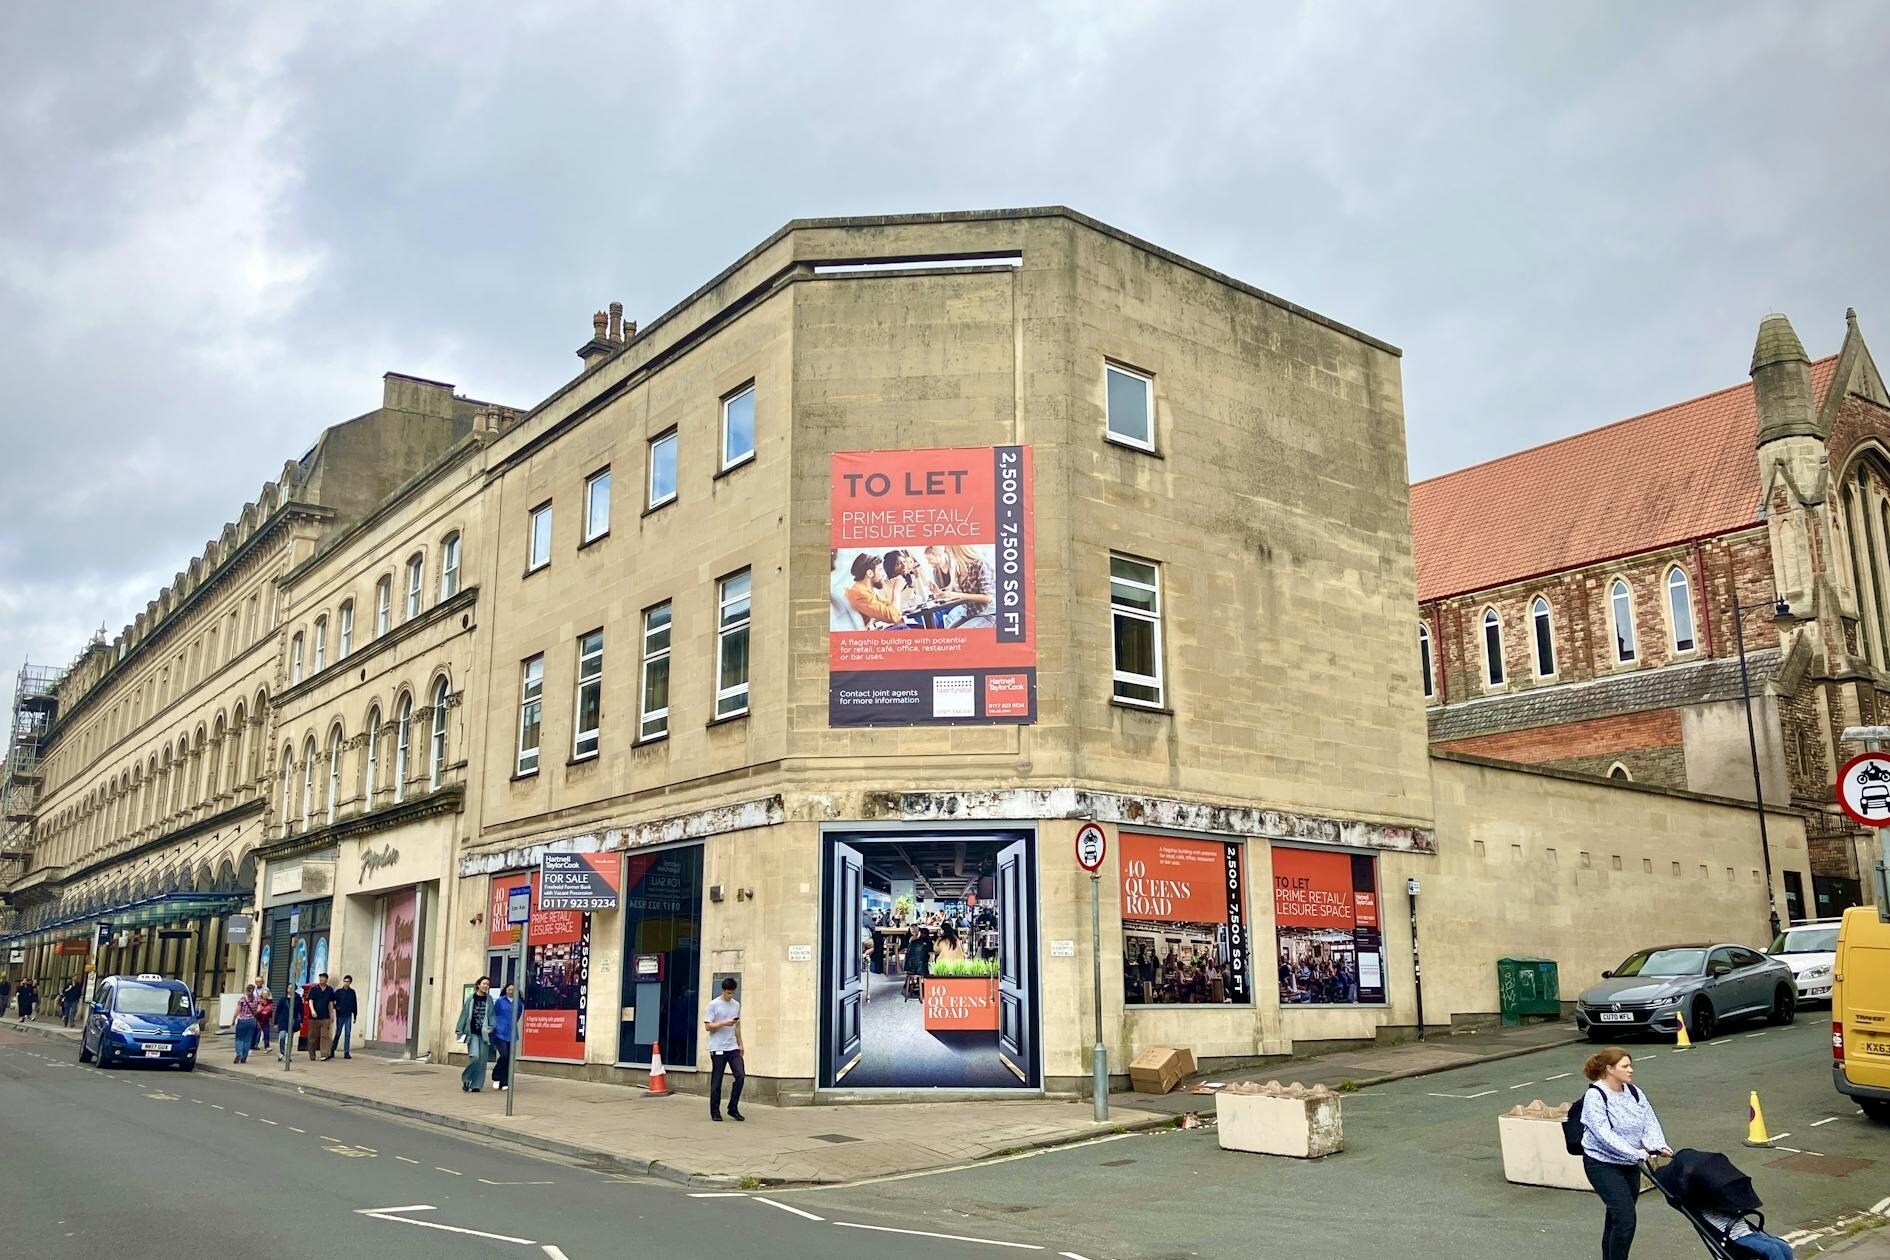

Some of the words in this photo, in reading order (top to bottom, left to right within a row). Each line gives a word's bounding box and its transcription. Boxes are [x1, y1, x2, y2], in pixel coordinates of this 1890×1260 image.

[843, 473, 891, 497] TO
[905, 470, 968, 496] LET
[1000, 452, 1017, 504] 2,500
[842, 510, 897, 525] PRIME
[903, 506, 974, 524] RETAIL/
[842, 524, 916, 540] LEISURE
[922, 522, 981, 538] SPACE
[1000, 523, 1018, 574] 7,500
[1004, 579, 1019, 607] SQ
[1004, 612, 1019, 635] FT
[849, 638, 879, 647] flagship
[881, 637, 912, 646] building
[933, 636, 967, 645] potential
[922, 644, 961, 652] restaurant
[989, 677, 1016, 685] Hartnell
[839, 697, 851, 705] for
[872, 689, 890, 698] joint
[892, 689, 918, 698] agents
[1226, 848, 1237, 889] 2,500
[544, 873, 564, 883] FOR
[566, 873, 589, 884] SALE
[1275, 876, 1289, 888] TO
[1292, 877, 1309, 889] LET
[1125, 878, 1191, 899] QUEENS
[1275, 889, 1306, 903] PRIME
[1309, 891, 1347, 905] RETAIL/
[543, 899, 568, 908] 0117
[570, 899, 589, 908] 923
[591, 899, 616, 908] 9234
[1126, 896, 1172, 915] ROAD
[1276, 902, 1318, 916] LEISURE
[1320, 905, 1351, 918] SPACE
[531, 912, 548, 924] PRIME
[1229, 904, 1240, 945] 7,500
[531, 923, 554, 936] LEISURE
[555, 921, 574, 933] SPACE
[1232, 949, 1241, 970] SQ
[1234, 975, 1243, 994] FT
[580, 985, 587, 1009] SQ
[928, 996, 987, 1009] QUEENS
[928, 1007, 969, 1018] ROAD
[579, 1015, 586, 1036] FT
